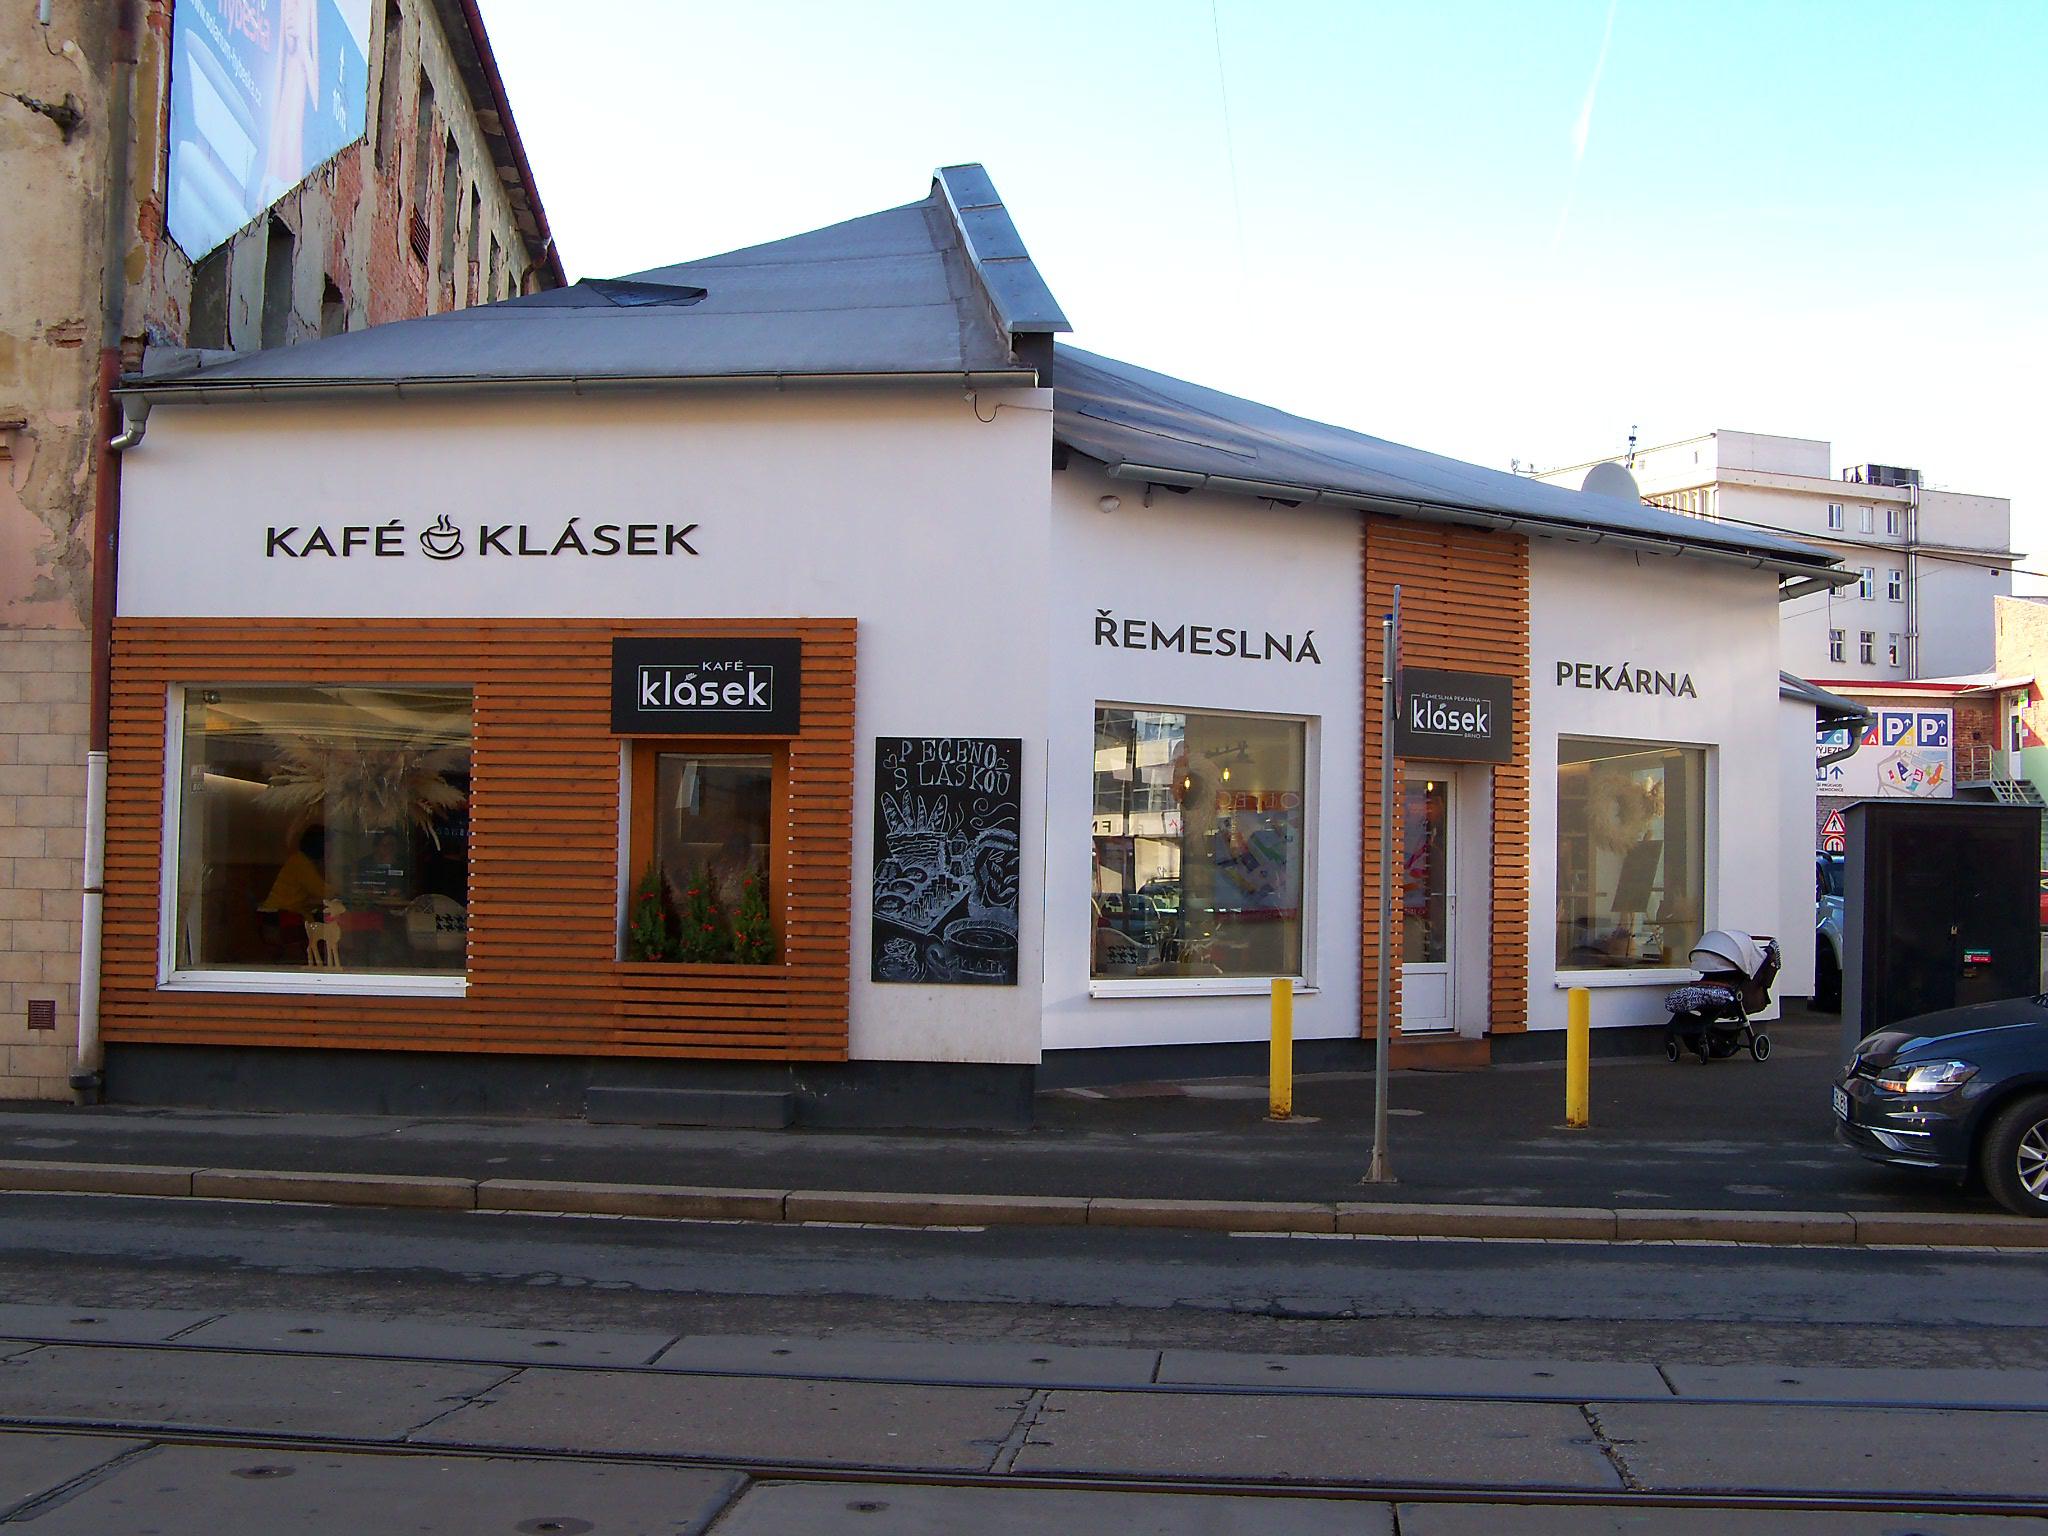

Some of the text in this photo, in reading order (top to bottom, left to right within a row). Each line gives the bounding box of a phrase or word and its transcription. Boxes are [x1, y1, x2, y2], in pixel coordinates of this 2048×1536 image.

[265, 517, 700, 557] KAFÉ KLÁSEK
[1095, 608, 1322, 664] ŘEMESLNÁ
[702, 660, 744, 671] KAFÉ
[642, 671, 768, 706] klásek
[1556, 661, 1698, 699] PEKÁRNA
[1413, 699, 1488, 733] klásek
[1868, 734, 1877, 745] A
[1886, 717, 1904, 742] P
[1921, 718, 1939, 743] P
[1938, 735, 1947, 746] D
[893, 767, 908, 791] S
